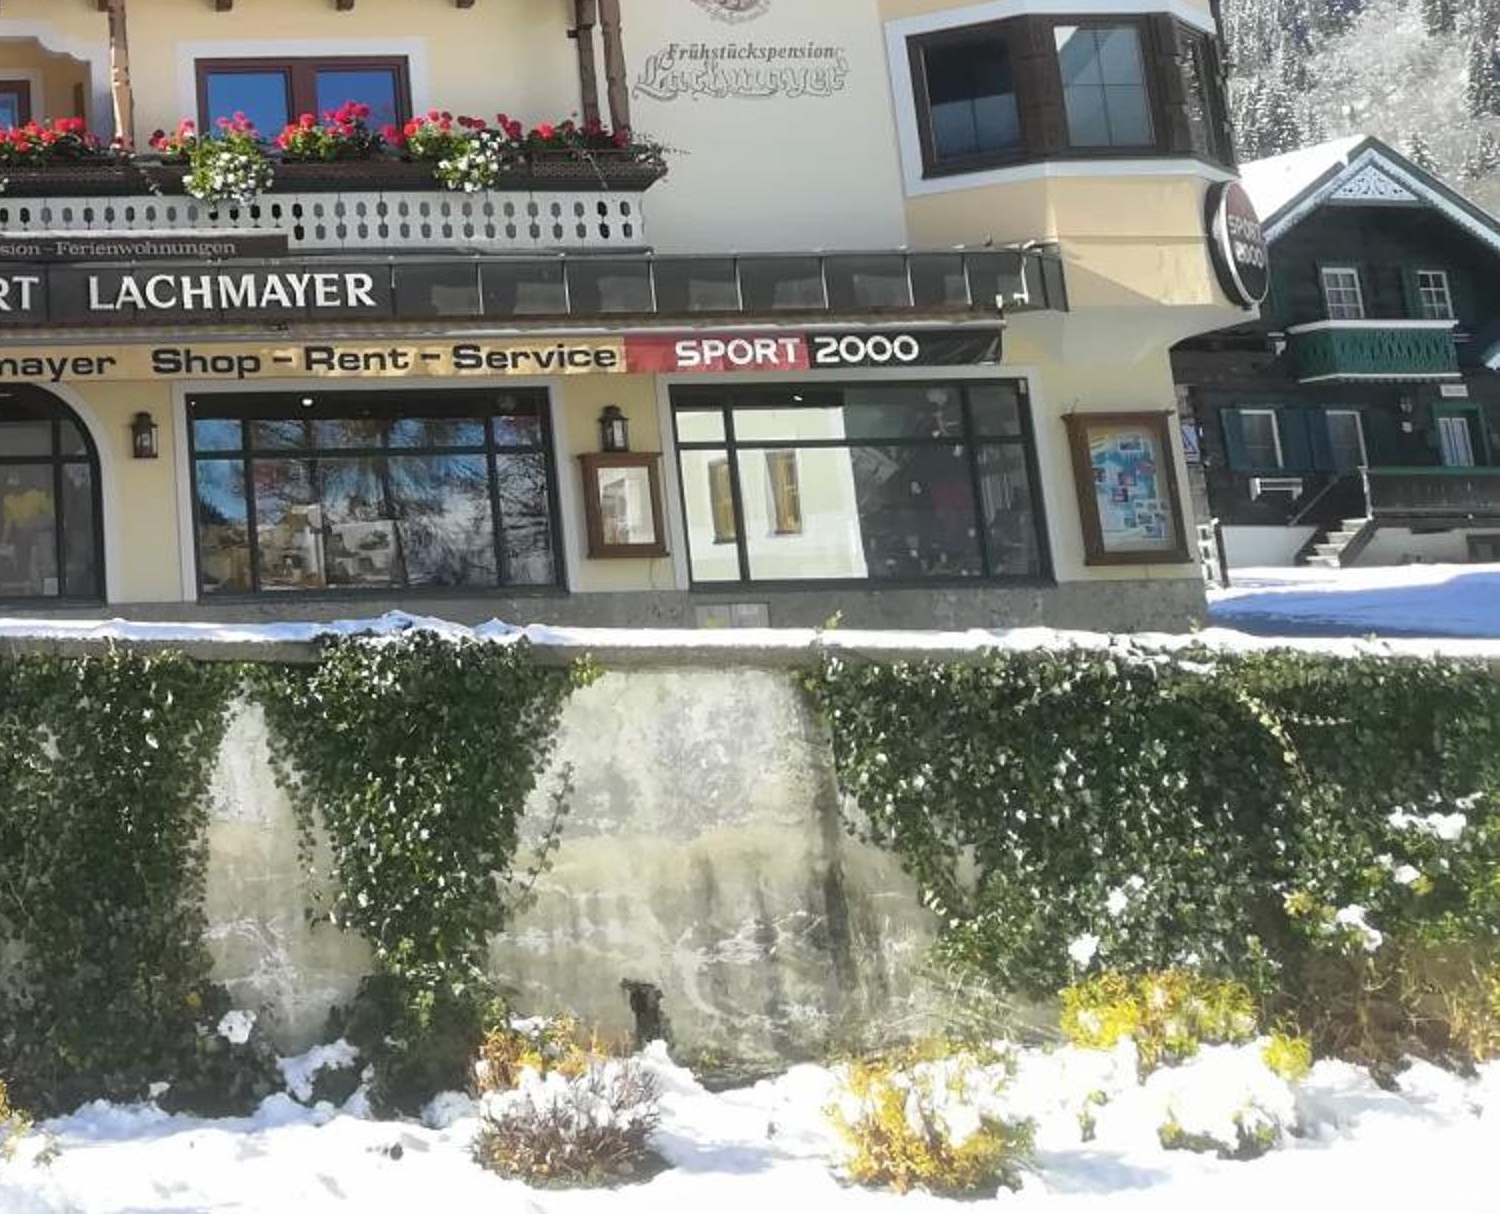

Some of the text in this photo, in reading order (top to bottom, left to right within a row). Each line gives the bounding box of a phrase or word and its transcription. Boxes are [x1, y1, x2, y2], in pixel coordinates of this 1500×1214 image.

[668, 42, 835, 62] Frühstückspension
[89, 272, 377, 311] LACHMAYER
[151, 347, 261, 379] Shop
[303, 345, 410, 372] Rent
[451, 343, 617, 370] Service
[675, 334, 920, 368] SPORT 2000
